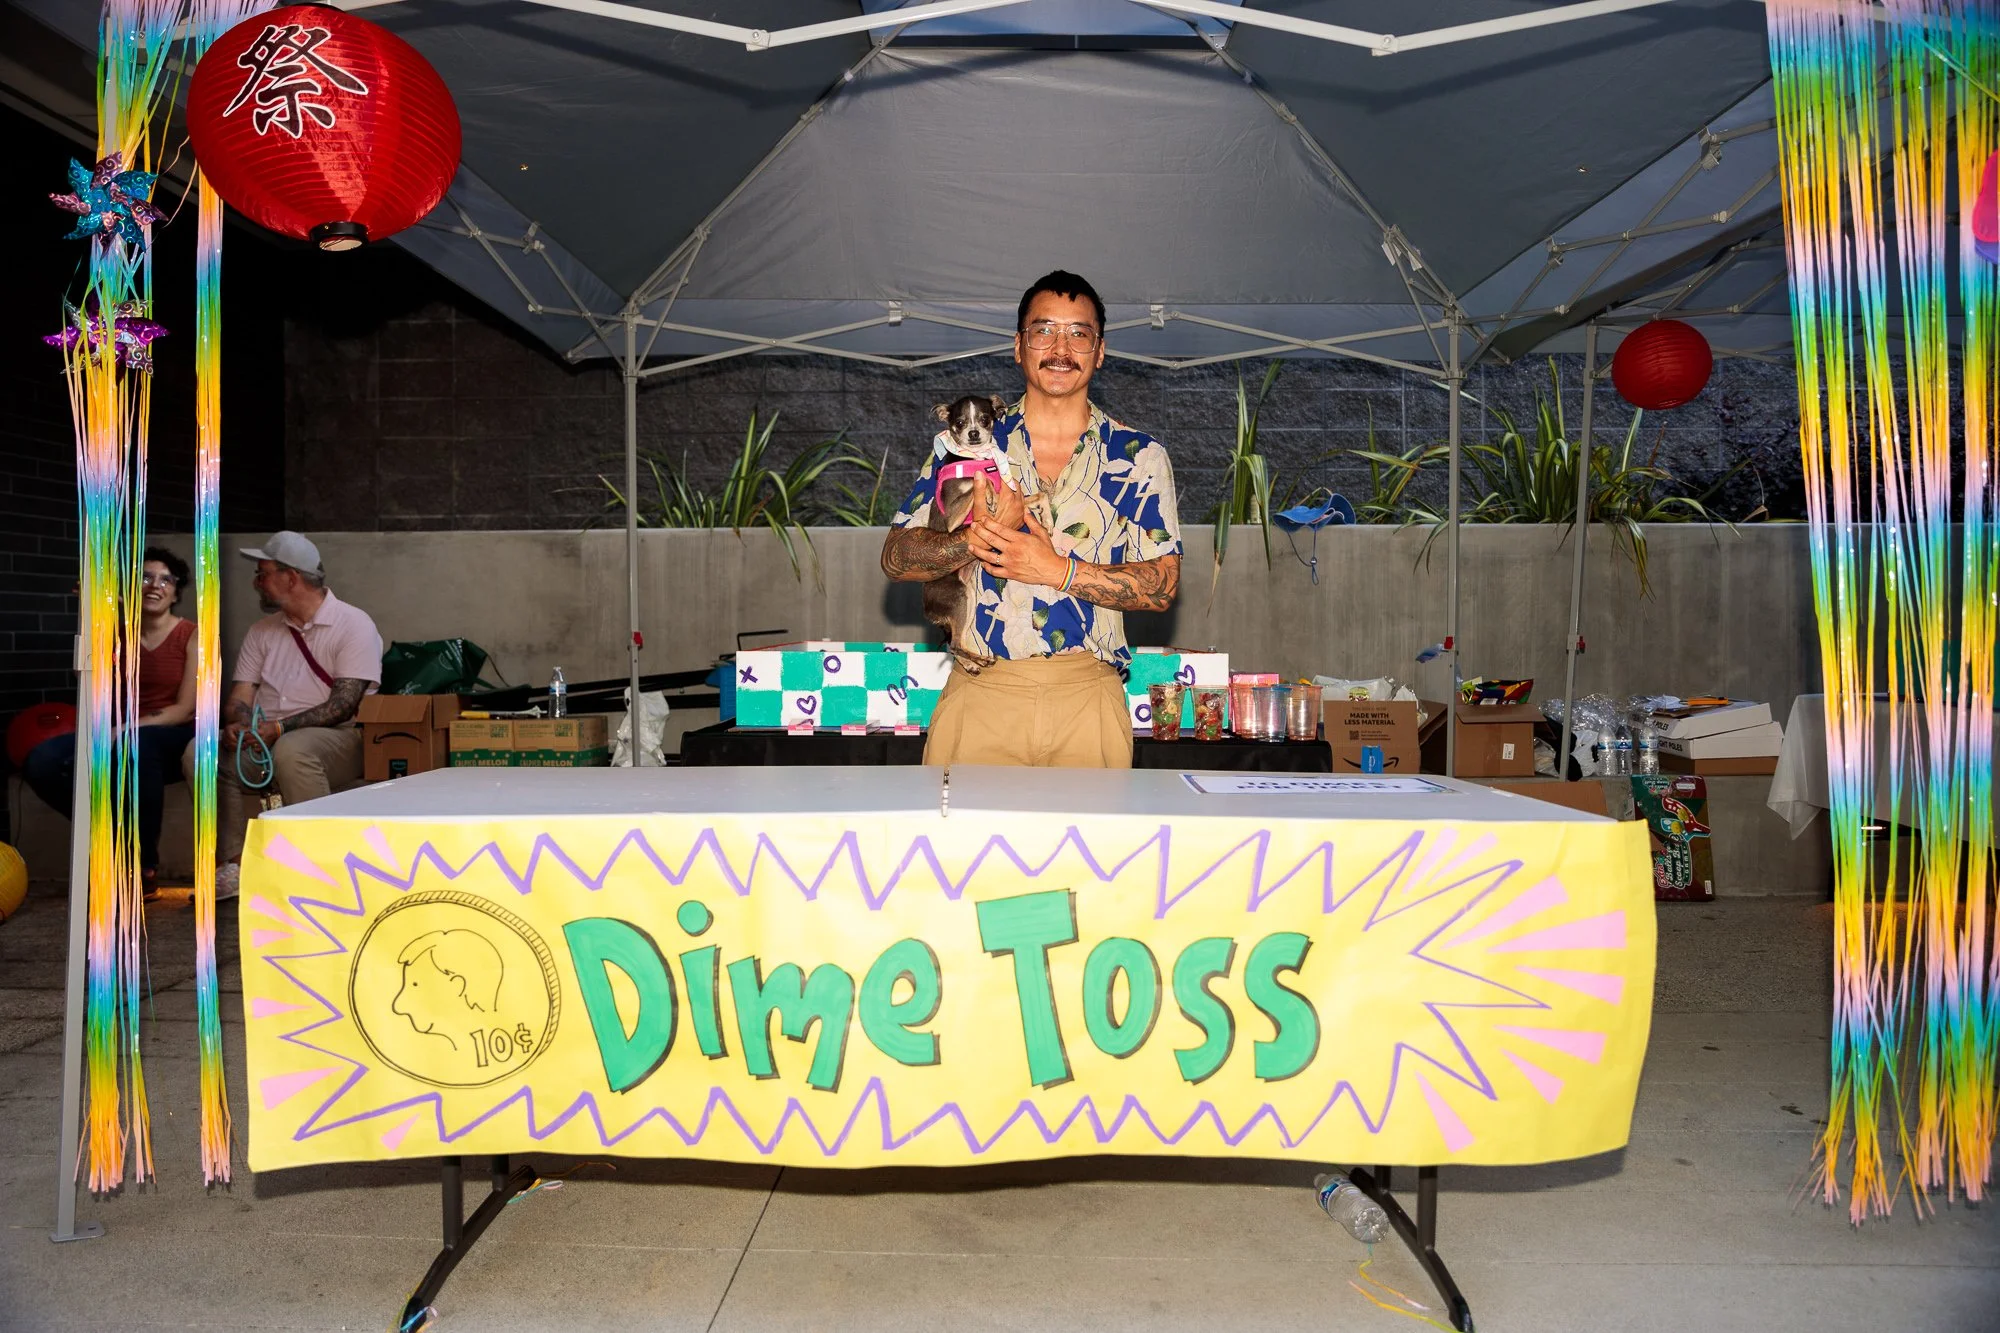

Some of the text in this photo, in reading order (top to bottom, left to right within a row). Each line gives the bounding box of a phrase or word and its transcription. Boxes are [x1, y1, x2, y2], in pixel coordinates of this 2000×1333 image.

[222, 24, 368, 138] 祭
[1669, 742, 1683, 752] POLES
[478, 759, 508, 767] MELON
[543, 759, 573, 767] MELON
[561, 887, 1322, 1094] Dime Toss
[469, 1022, 533, 1068] 10¢
